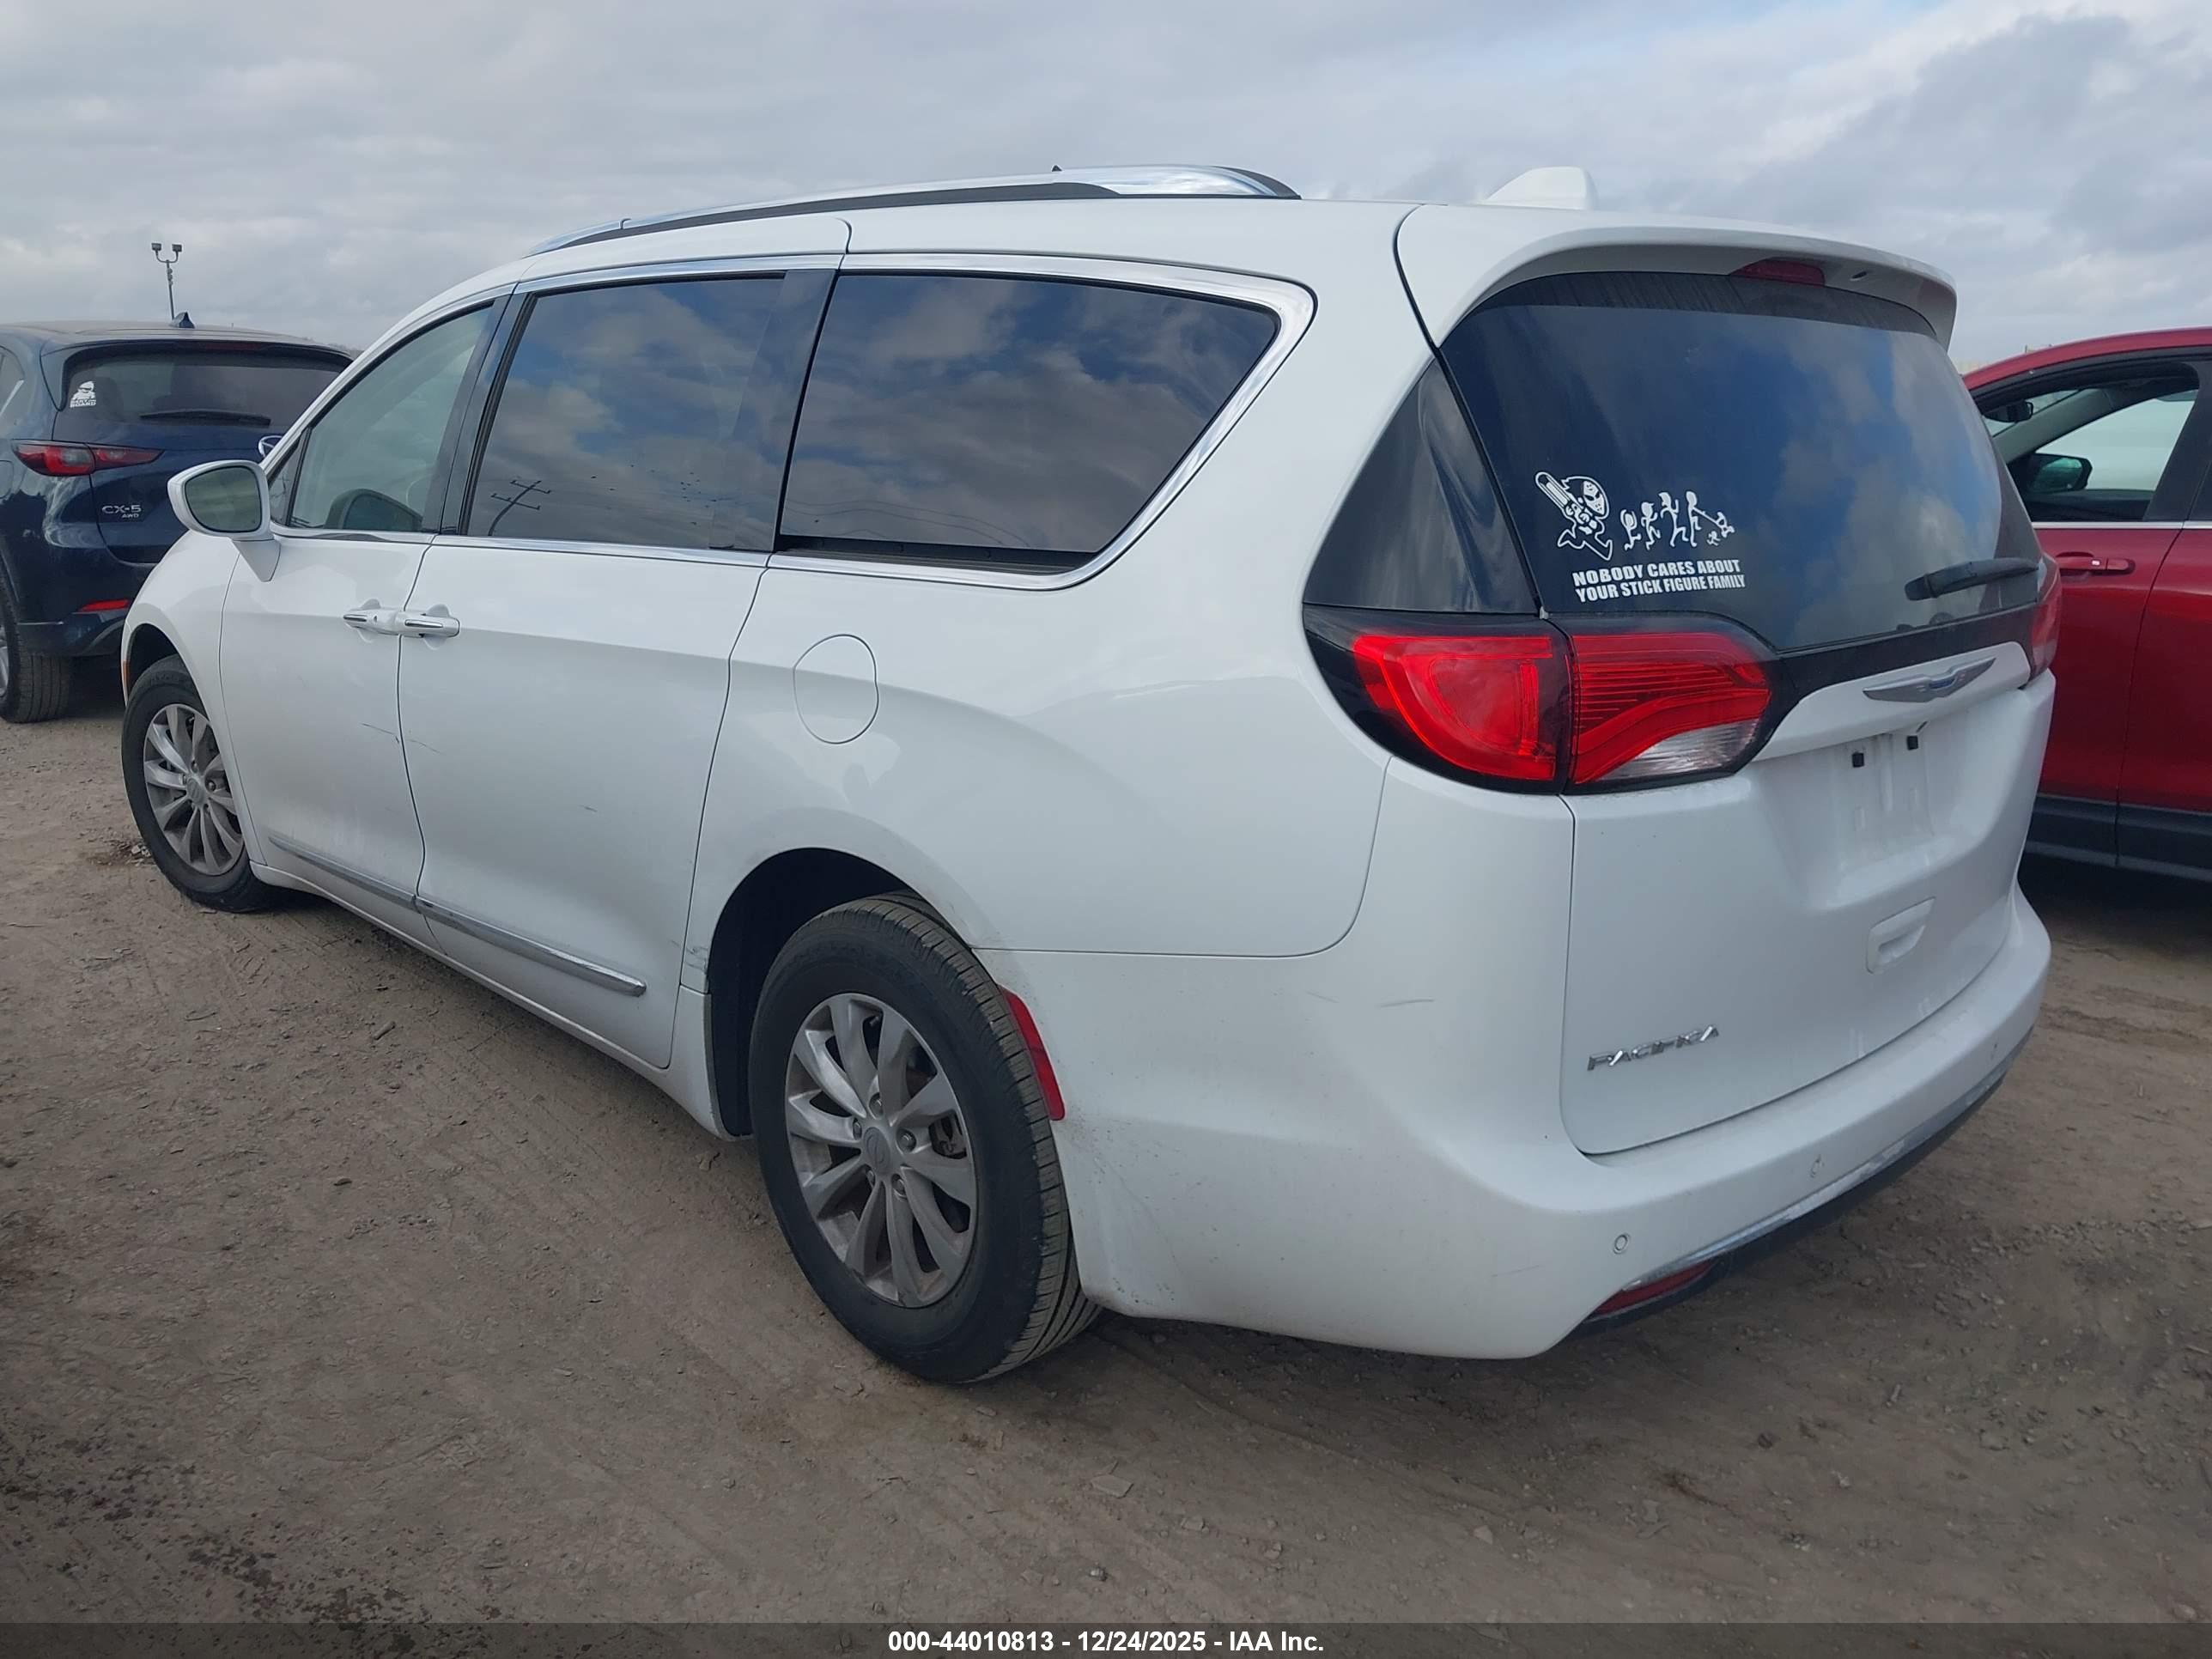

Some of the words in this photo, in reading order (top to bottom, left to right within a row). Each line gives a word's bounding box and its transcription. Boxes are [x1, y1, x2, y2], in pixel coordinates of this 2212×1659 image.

[102, 505, 142, 514] CX-5
[1572, 565, 1644, 586] NOBODY
[1647, 561, 1693, 577] CARES
[1697, 559, 1741, 574] ABOUT
[1576, 584, 1620, 603] YOUR
[1622, 580, 1662, 596] STICK
[1664, 576, 1707, 592] FIGURE
[1708, 574, 1746, 589] FAMILY
[1587, 1024, 1719, 1071] PACIFICA
